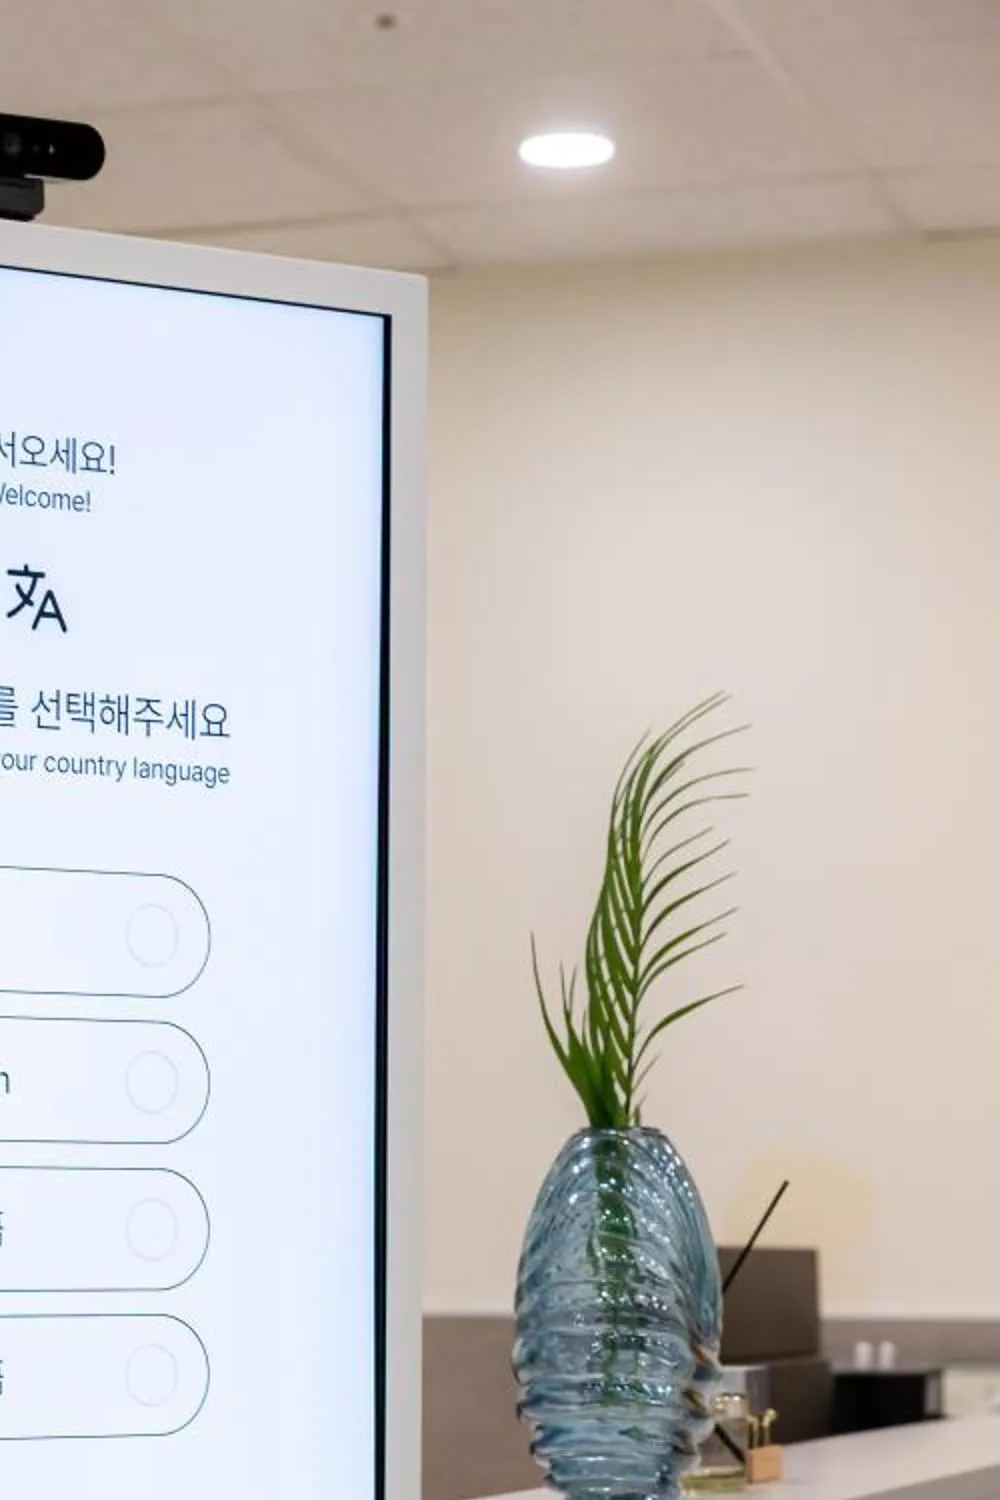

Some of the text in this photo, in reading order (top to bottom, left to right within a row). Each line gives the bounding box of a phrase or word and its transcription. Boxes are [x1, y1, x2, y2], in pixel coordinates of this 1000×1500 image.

[30, 688, 231, 740] 선택해주세요
[44, 752, 127, 782] country
[132, 756, 231, 789] language
